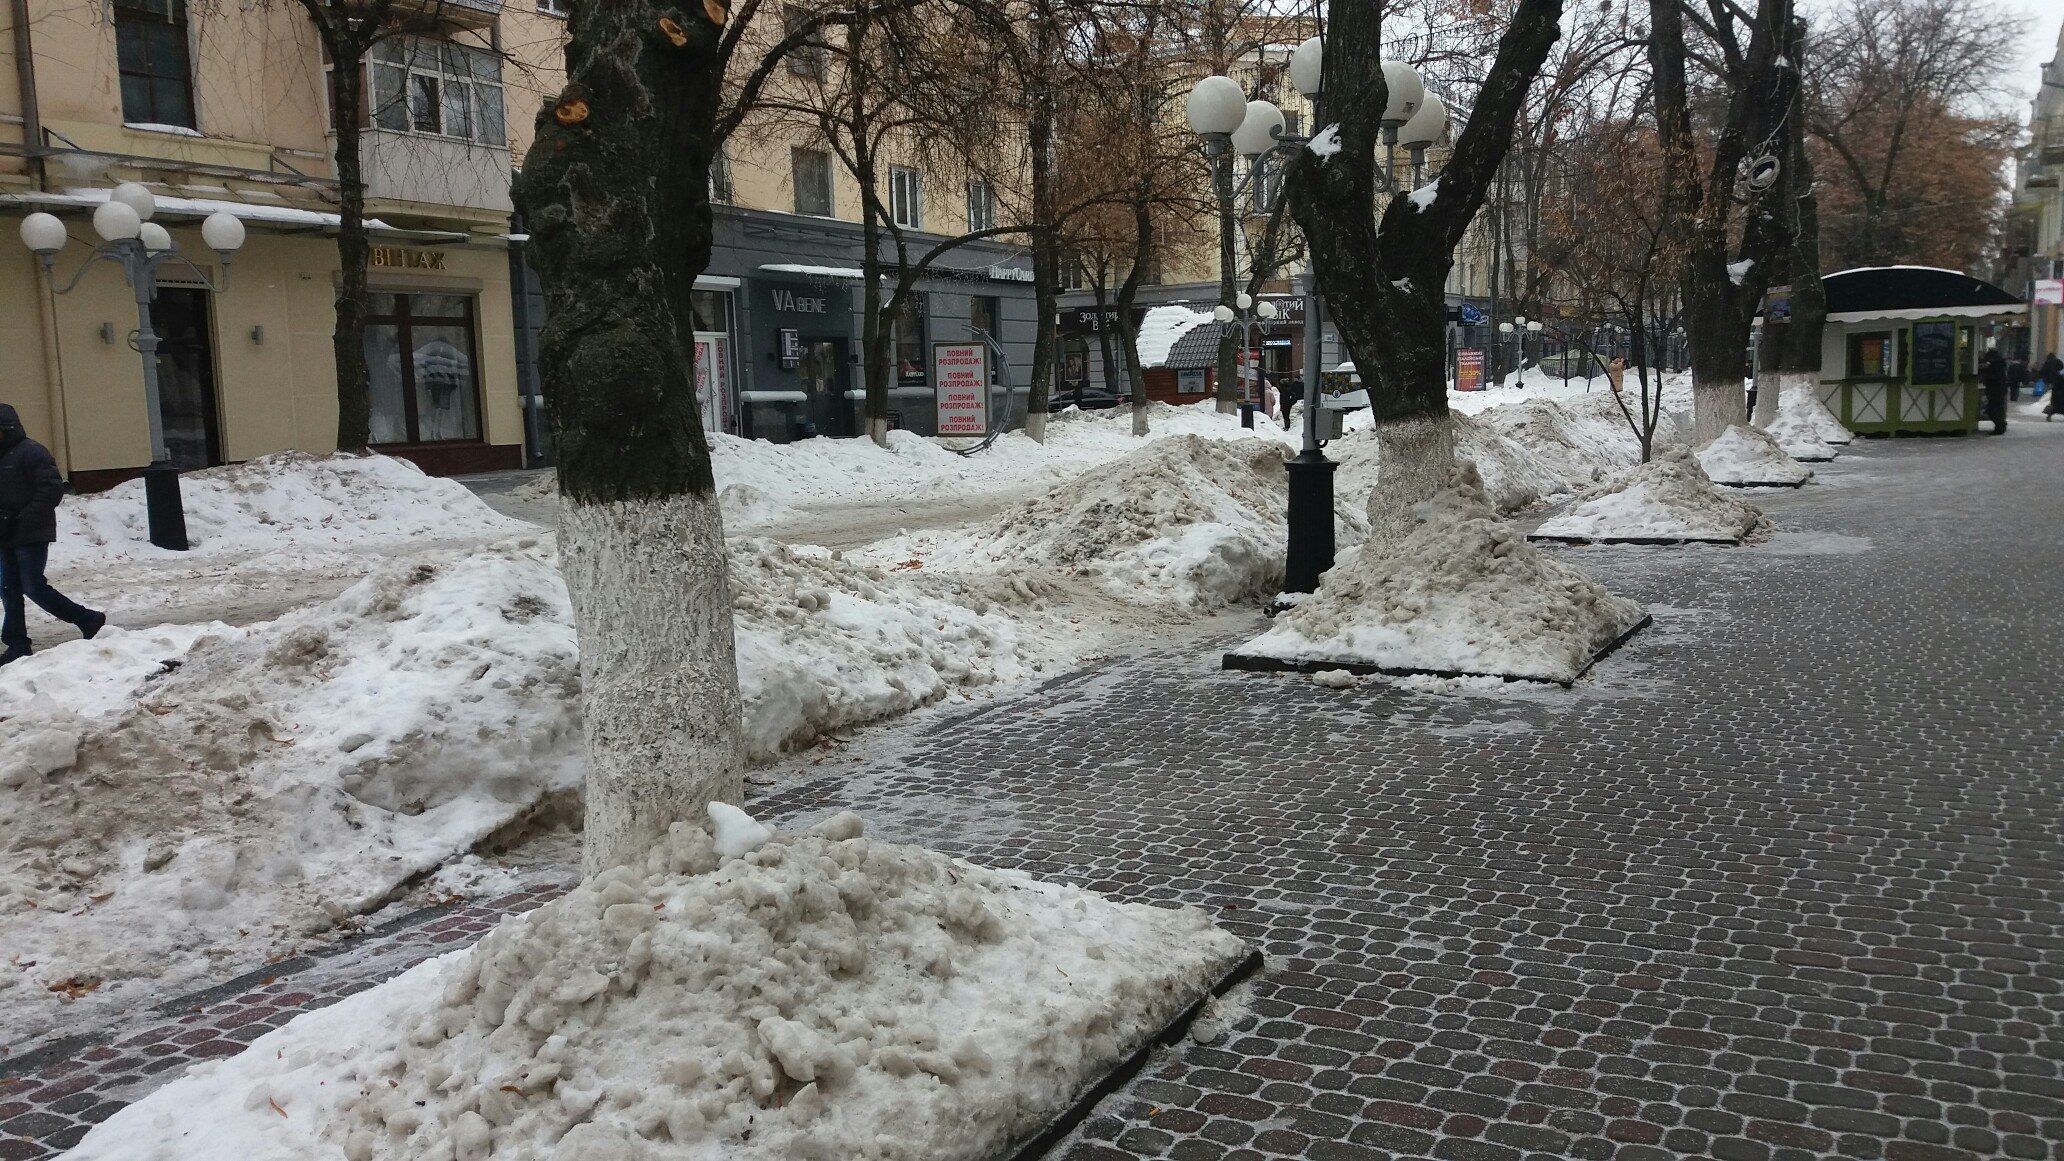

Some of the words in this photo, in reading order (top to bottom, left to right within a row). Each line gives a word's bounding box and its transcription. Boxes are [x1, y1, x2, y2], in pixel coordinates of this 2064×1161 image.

[772, 289, 795, 311] VA
[796, 297, 826, 313] BENE
[1258, 298, 1304, 311] ЛОТИЙ
[1079, 311, 1119, 323] ЗОЛТИ
[947, 348, 973, 357] ПОВНИЙ
[938, 358, 982, 366] РОЗПРОДАЖ!
[947, 370, 974, 379] ПОВНИЙ
[939, 380, 983, 388] РОЗПРОДАЖ!
[948, 393, 975, 402] ПОВНИЙ
[940, 402, 984, 410] РОЗПРОДАЖ!
[949, 415, 976, 423] ПОВНИЙ
[940, 424, 984, 432] РОЗПРОДАЖ!
